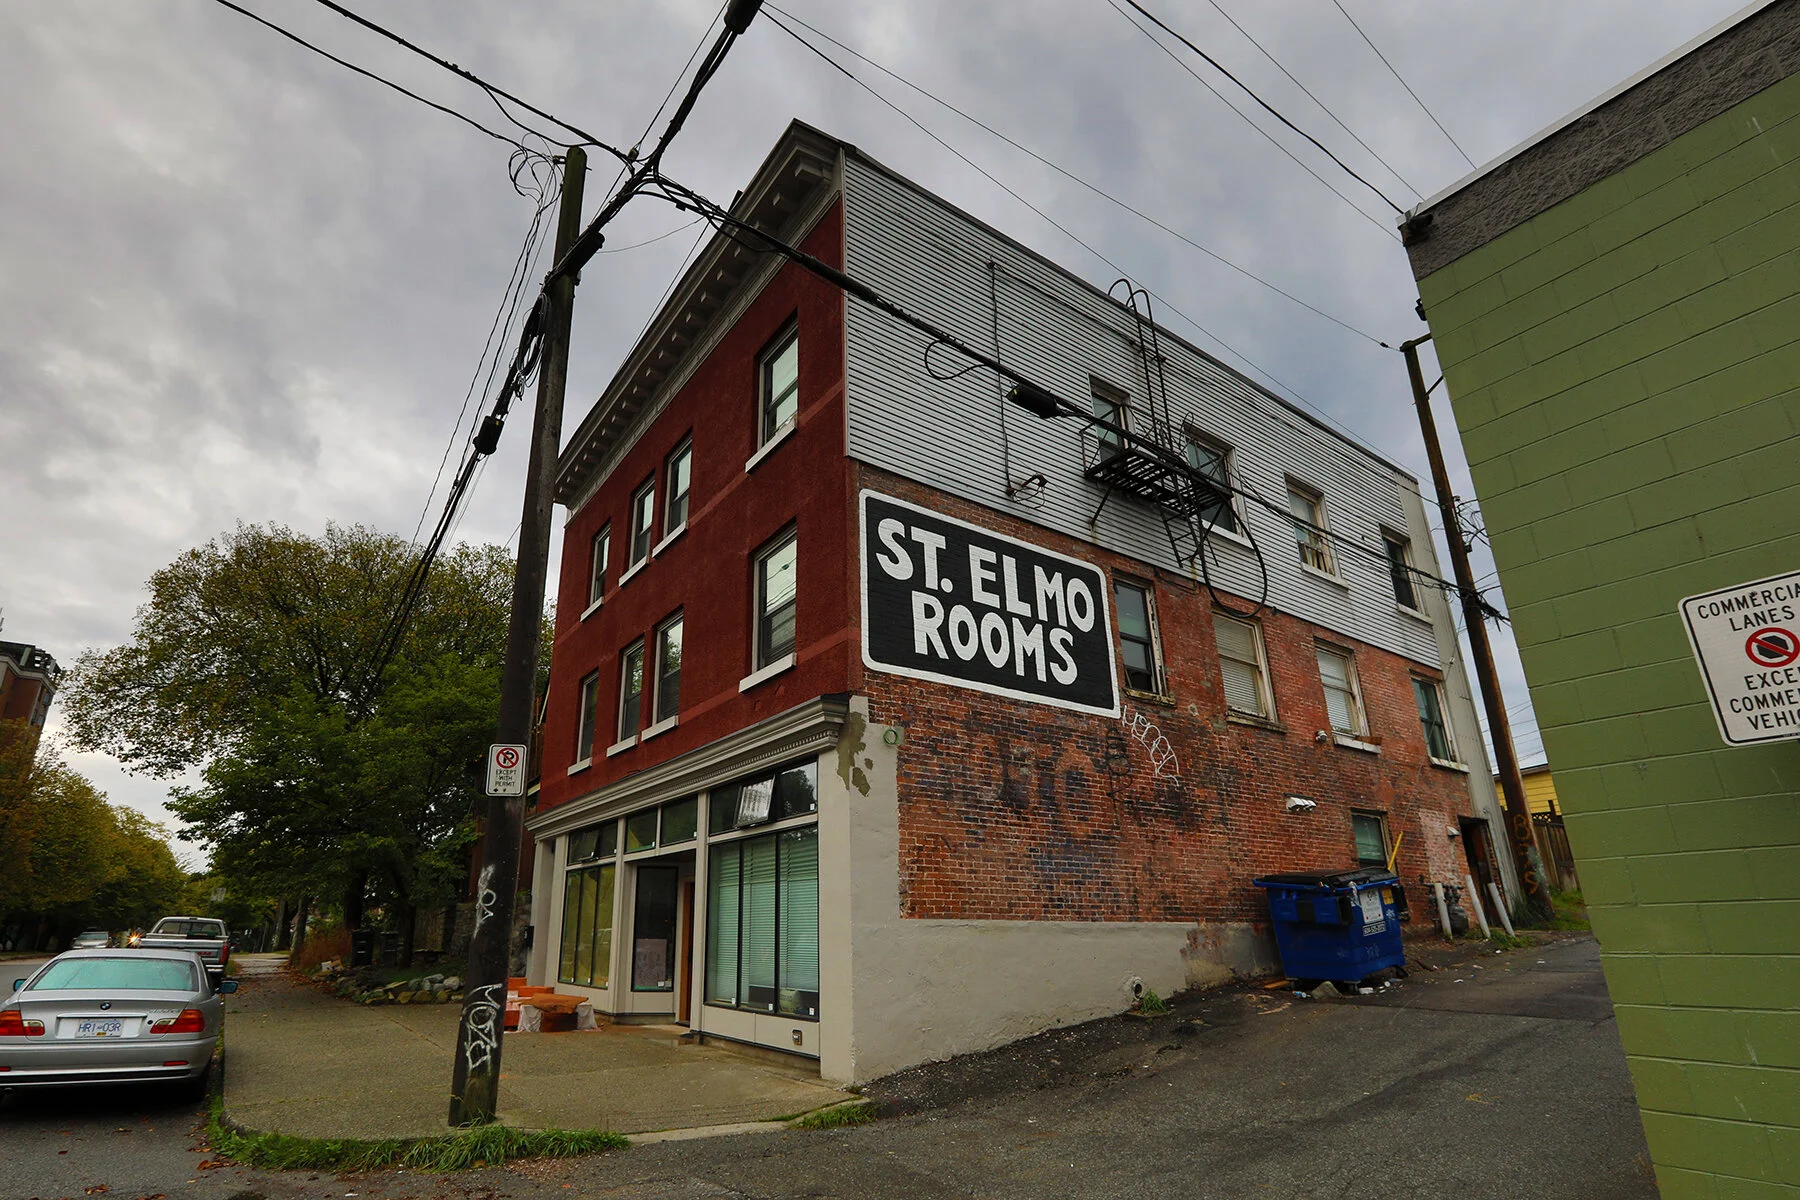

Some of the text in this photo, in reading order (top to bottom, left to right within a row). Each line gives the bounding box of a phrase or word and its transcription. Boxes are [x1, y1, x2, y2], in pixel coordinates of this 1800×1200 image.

[875, 518, 1095, 633] ST. ELMO
[1729, 605, 1795, 632] LANES
[911, 590, 1078, 685] ROOMS
[1744, 666, 1800, 691] EXCE
[1729, 687, 1800, 714] COMME
